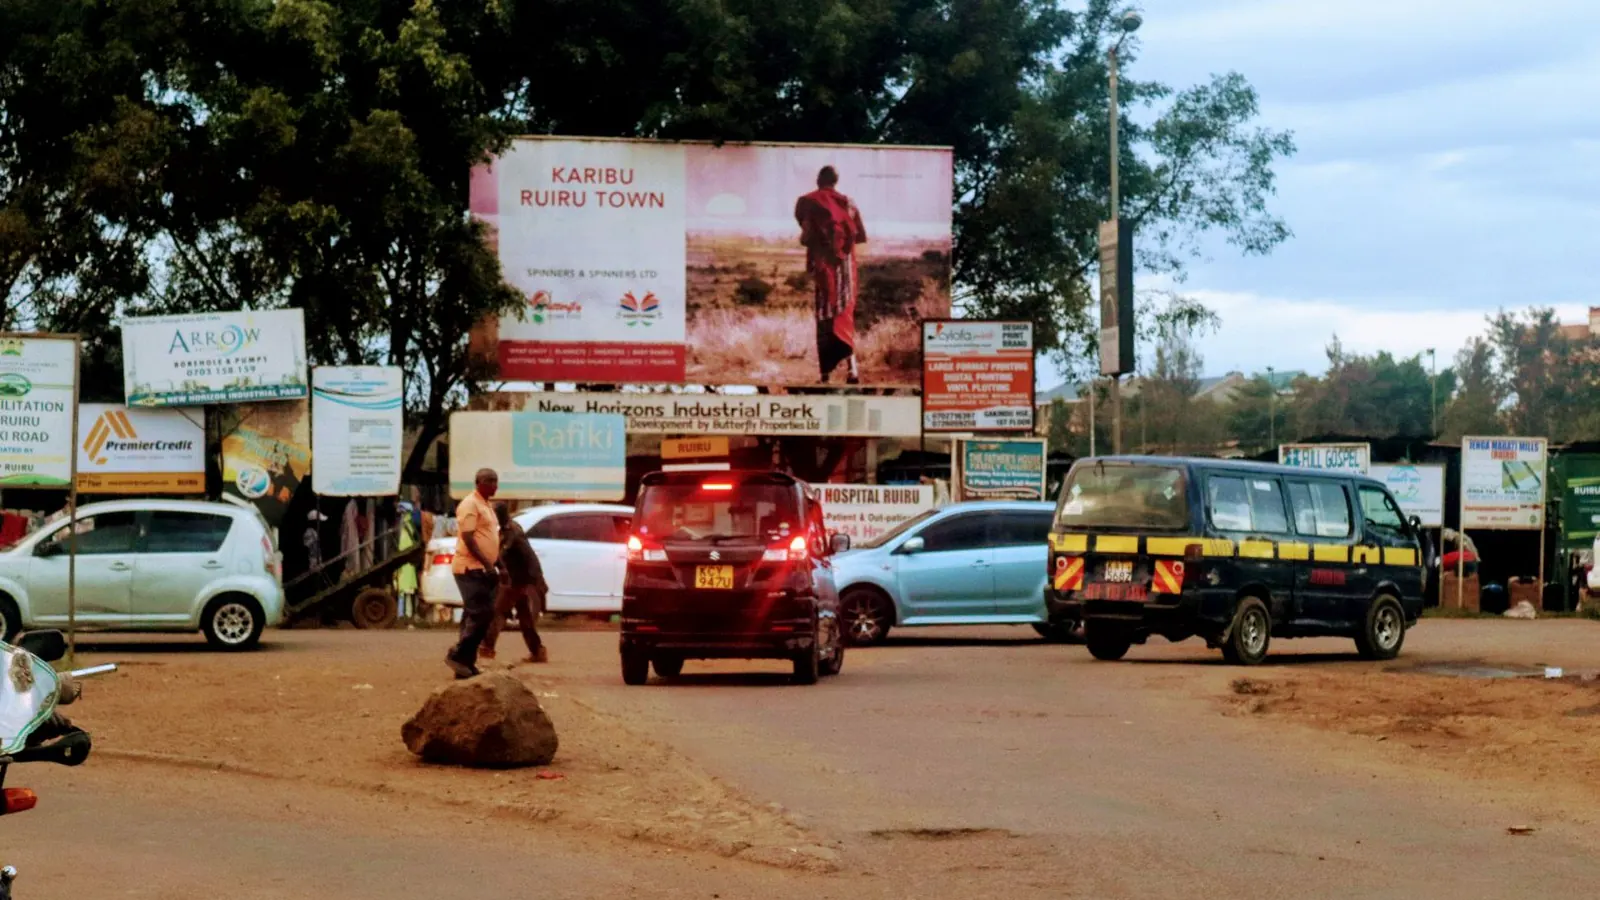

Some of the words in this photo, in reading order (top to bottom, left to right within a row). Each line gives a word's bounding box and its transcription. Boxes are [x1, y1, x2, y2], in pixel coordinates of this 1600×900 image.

[552, 167, 634, 184] KARIBU
[520, 190, 586, 207] RUIRU
[595, 191, 665, 208] TOWN
[527, 268, 575, 278] SPINNERS
[578, 270, 585, 278] &
[589, 270, 637, 278] SPINNERS
[639, 271, 658, 279] LTD
[168, 327, 261, 355] ARROW
[174, 359, 223, 368] BOREHOLE
[228, 391, 278, 400] INDUSTRIAL
[539, 400, 574, 413] New
[586, 400, 665, 417] Horizons
[673, 402, 760, 417] Industrial
[769, 403, 813, 418] Park
[0, 415, 40, 427] RUIRU
[630, 418, 692, 431] Development
[697, 419, 709, 431] by
[712, 419, 756, 431] Butterfly
[759, 419, 804, 431] Properties
[806, 420, 820, 431] Ltd
[12, 431, 49, 442] ROAD
[528, 420, 614, 450] Rafiki
[106, 440, 192, 451] PremierCredit
[677, 442, 712, 453] RUIRU
[1302, 447, 1322, 468] FULL
[1326, 448, 1360, 468] GOSPEL
[5, 463, 34, 472] RUIRU
[825, 487, 881, 504] HOSPITAL
[884, 488, 920, 504] RUIRU
[859, 513, 865, 521] &
[699, 577, 732, 588] 947U
